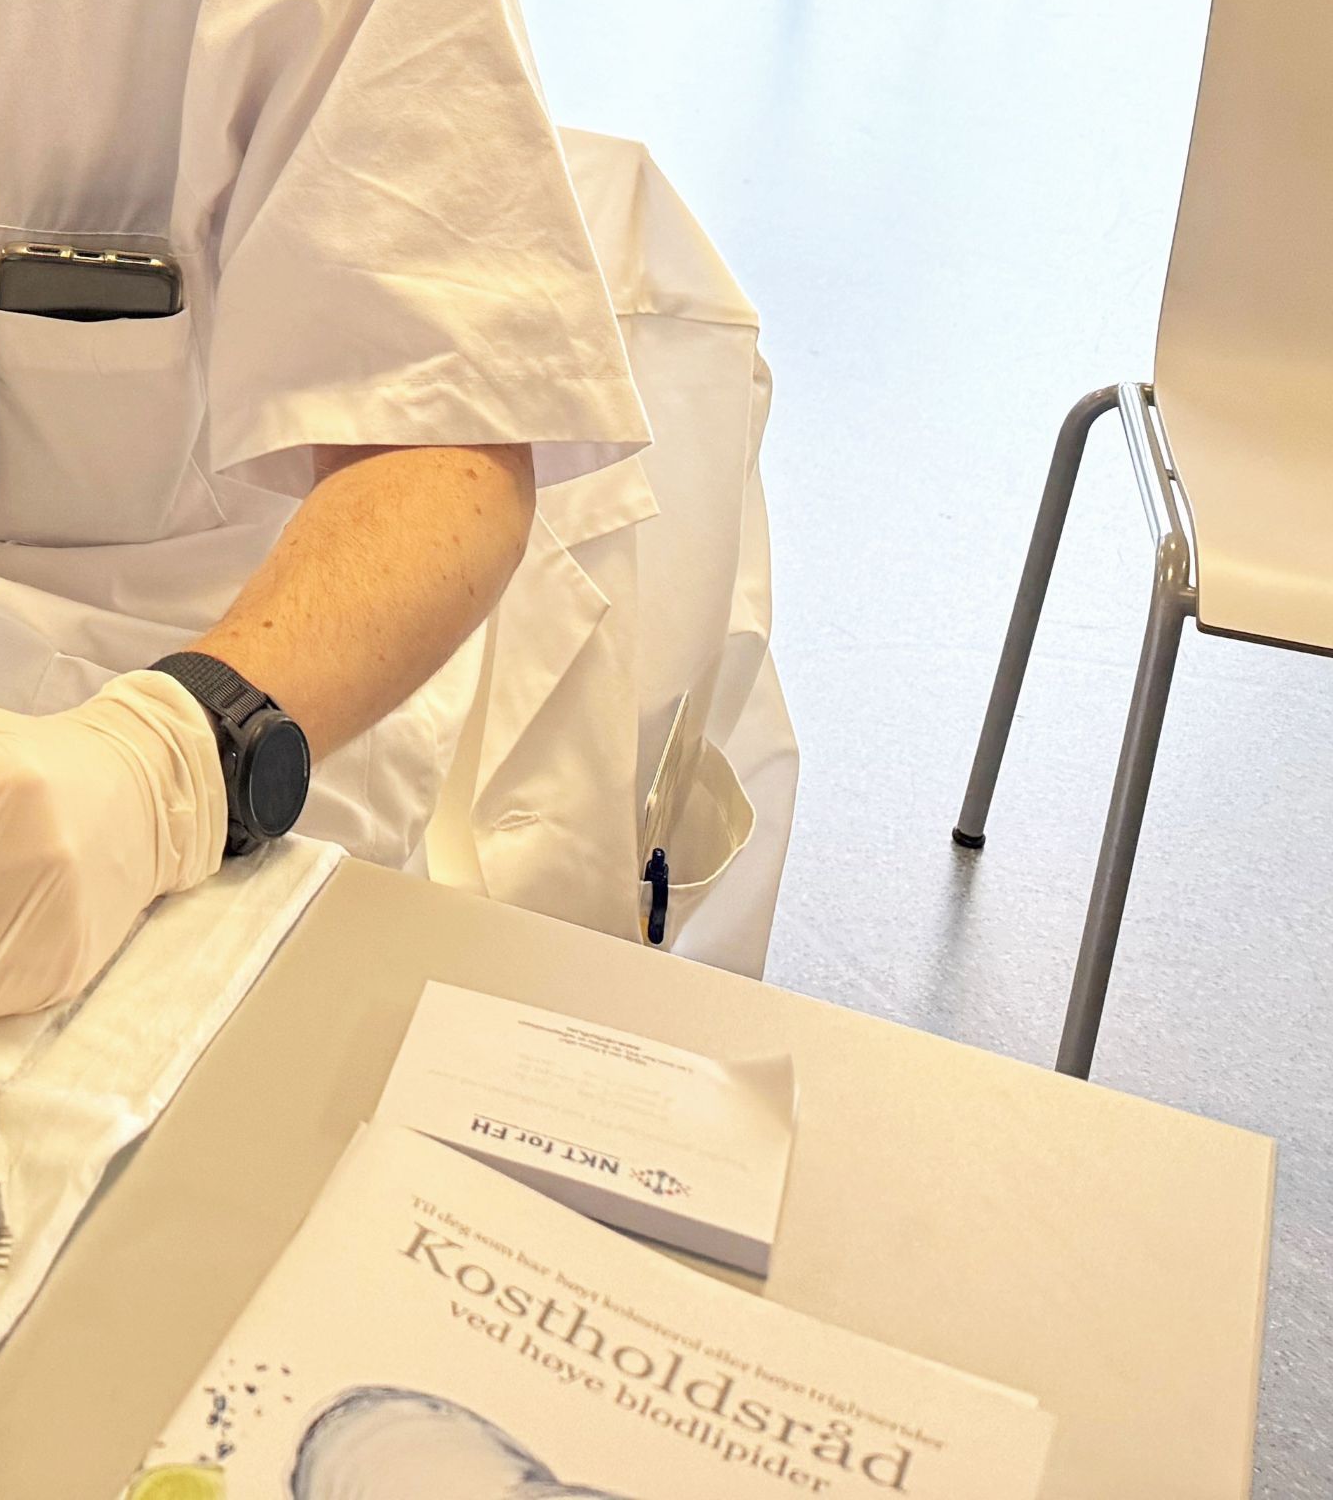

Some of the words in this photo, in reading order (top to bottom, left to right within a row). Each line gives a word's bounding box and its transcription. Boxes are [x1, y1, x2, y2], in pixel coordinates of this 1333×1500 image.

[471, 1116, 508, 1141] FH
[515, 1131, 554, 1155] for
[561, 1146, 619, 1176] NKT
[411, 1195, 438, 1217] Til
[438, 1212, 471, 1238] deg
[475, 1232, 513, 1257] som
[517, 1251, 551, 1276] har
[602, 1296, 702, 1352] kolesterol
[703, 1346, 750, 1372] eller
[399, 1221, 913, 1492] Kostholdsråd
[450, 1301, 512, 1344] ved
[518, 1334, 605, 1391] høye
[615, 1381, 833, 1494] blodlipider
